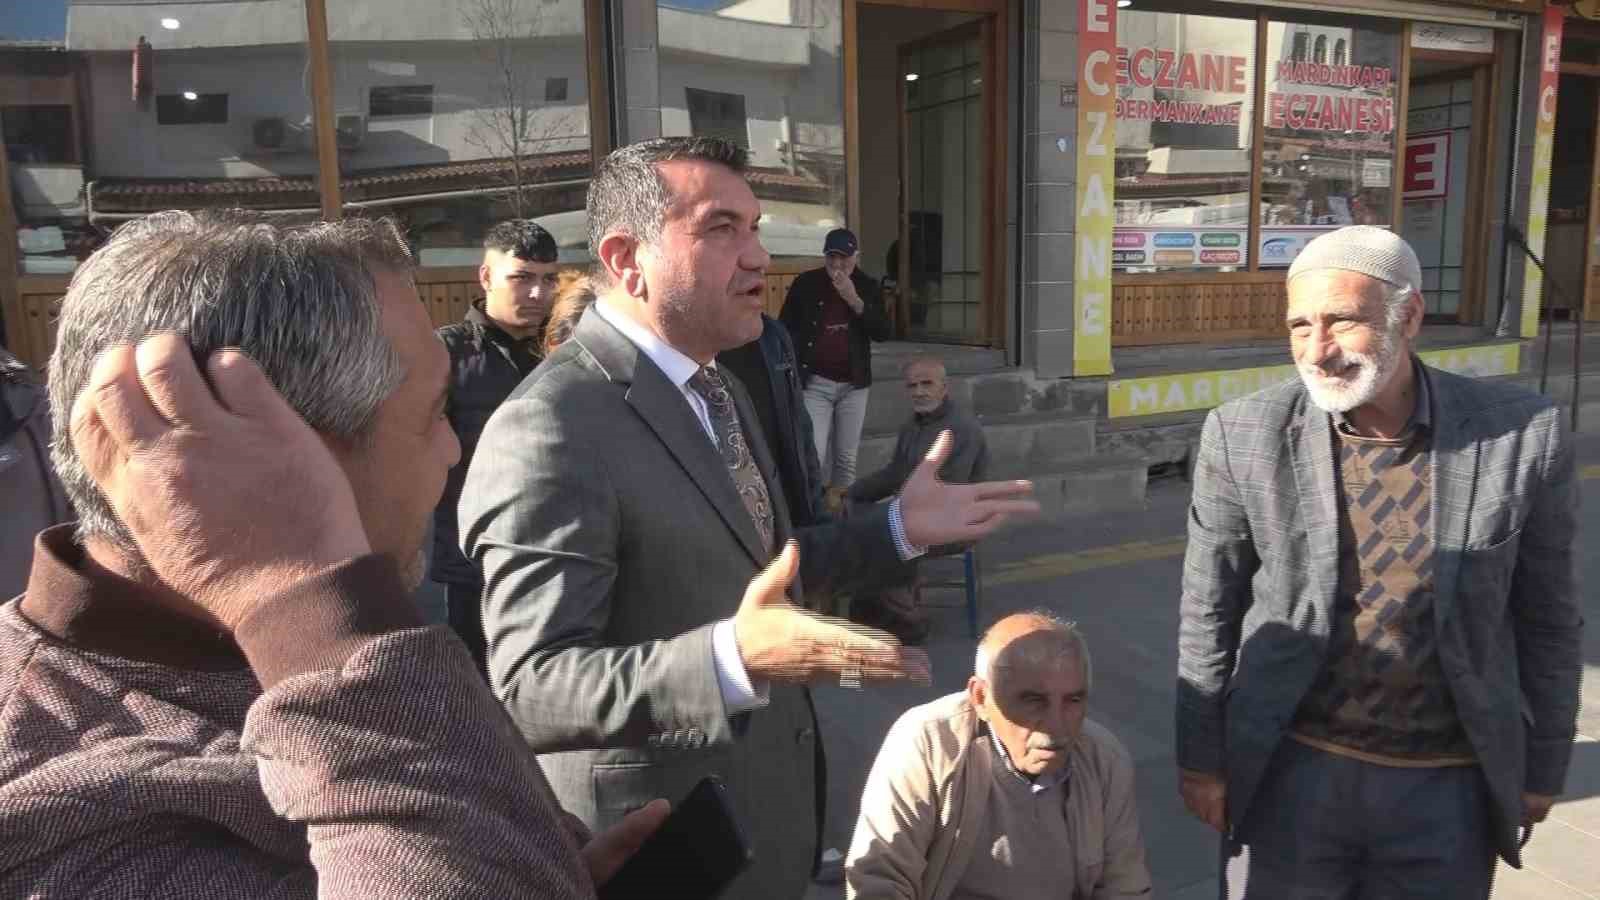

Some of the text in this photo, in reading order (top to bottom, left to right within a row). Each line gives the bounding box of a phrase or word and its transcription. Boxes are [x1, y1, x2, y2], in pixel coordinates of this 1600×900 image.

[1116, 46, 1247, 93] ECZANE
[1115, 99, 1241, 124] DERMANXANE
[1080, 0, 1111, 337] ECZANE
[1404, 143, 1436, 191] E
